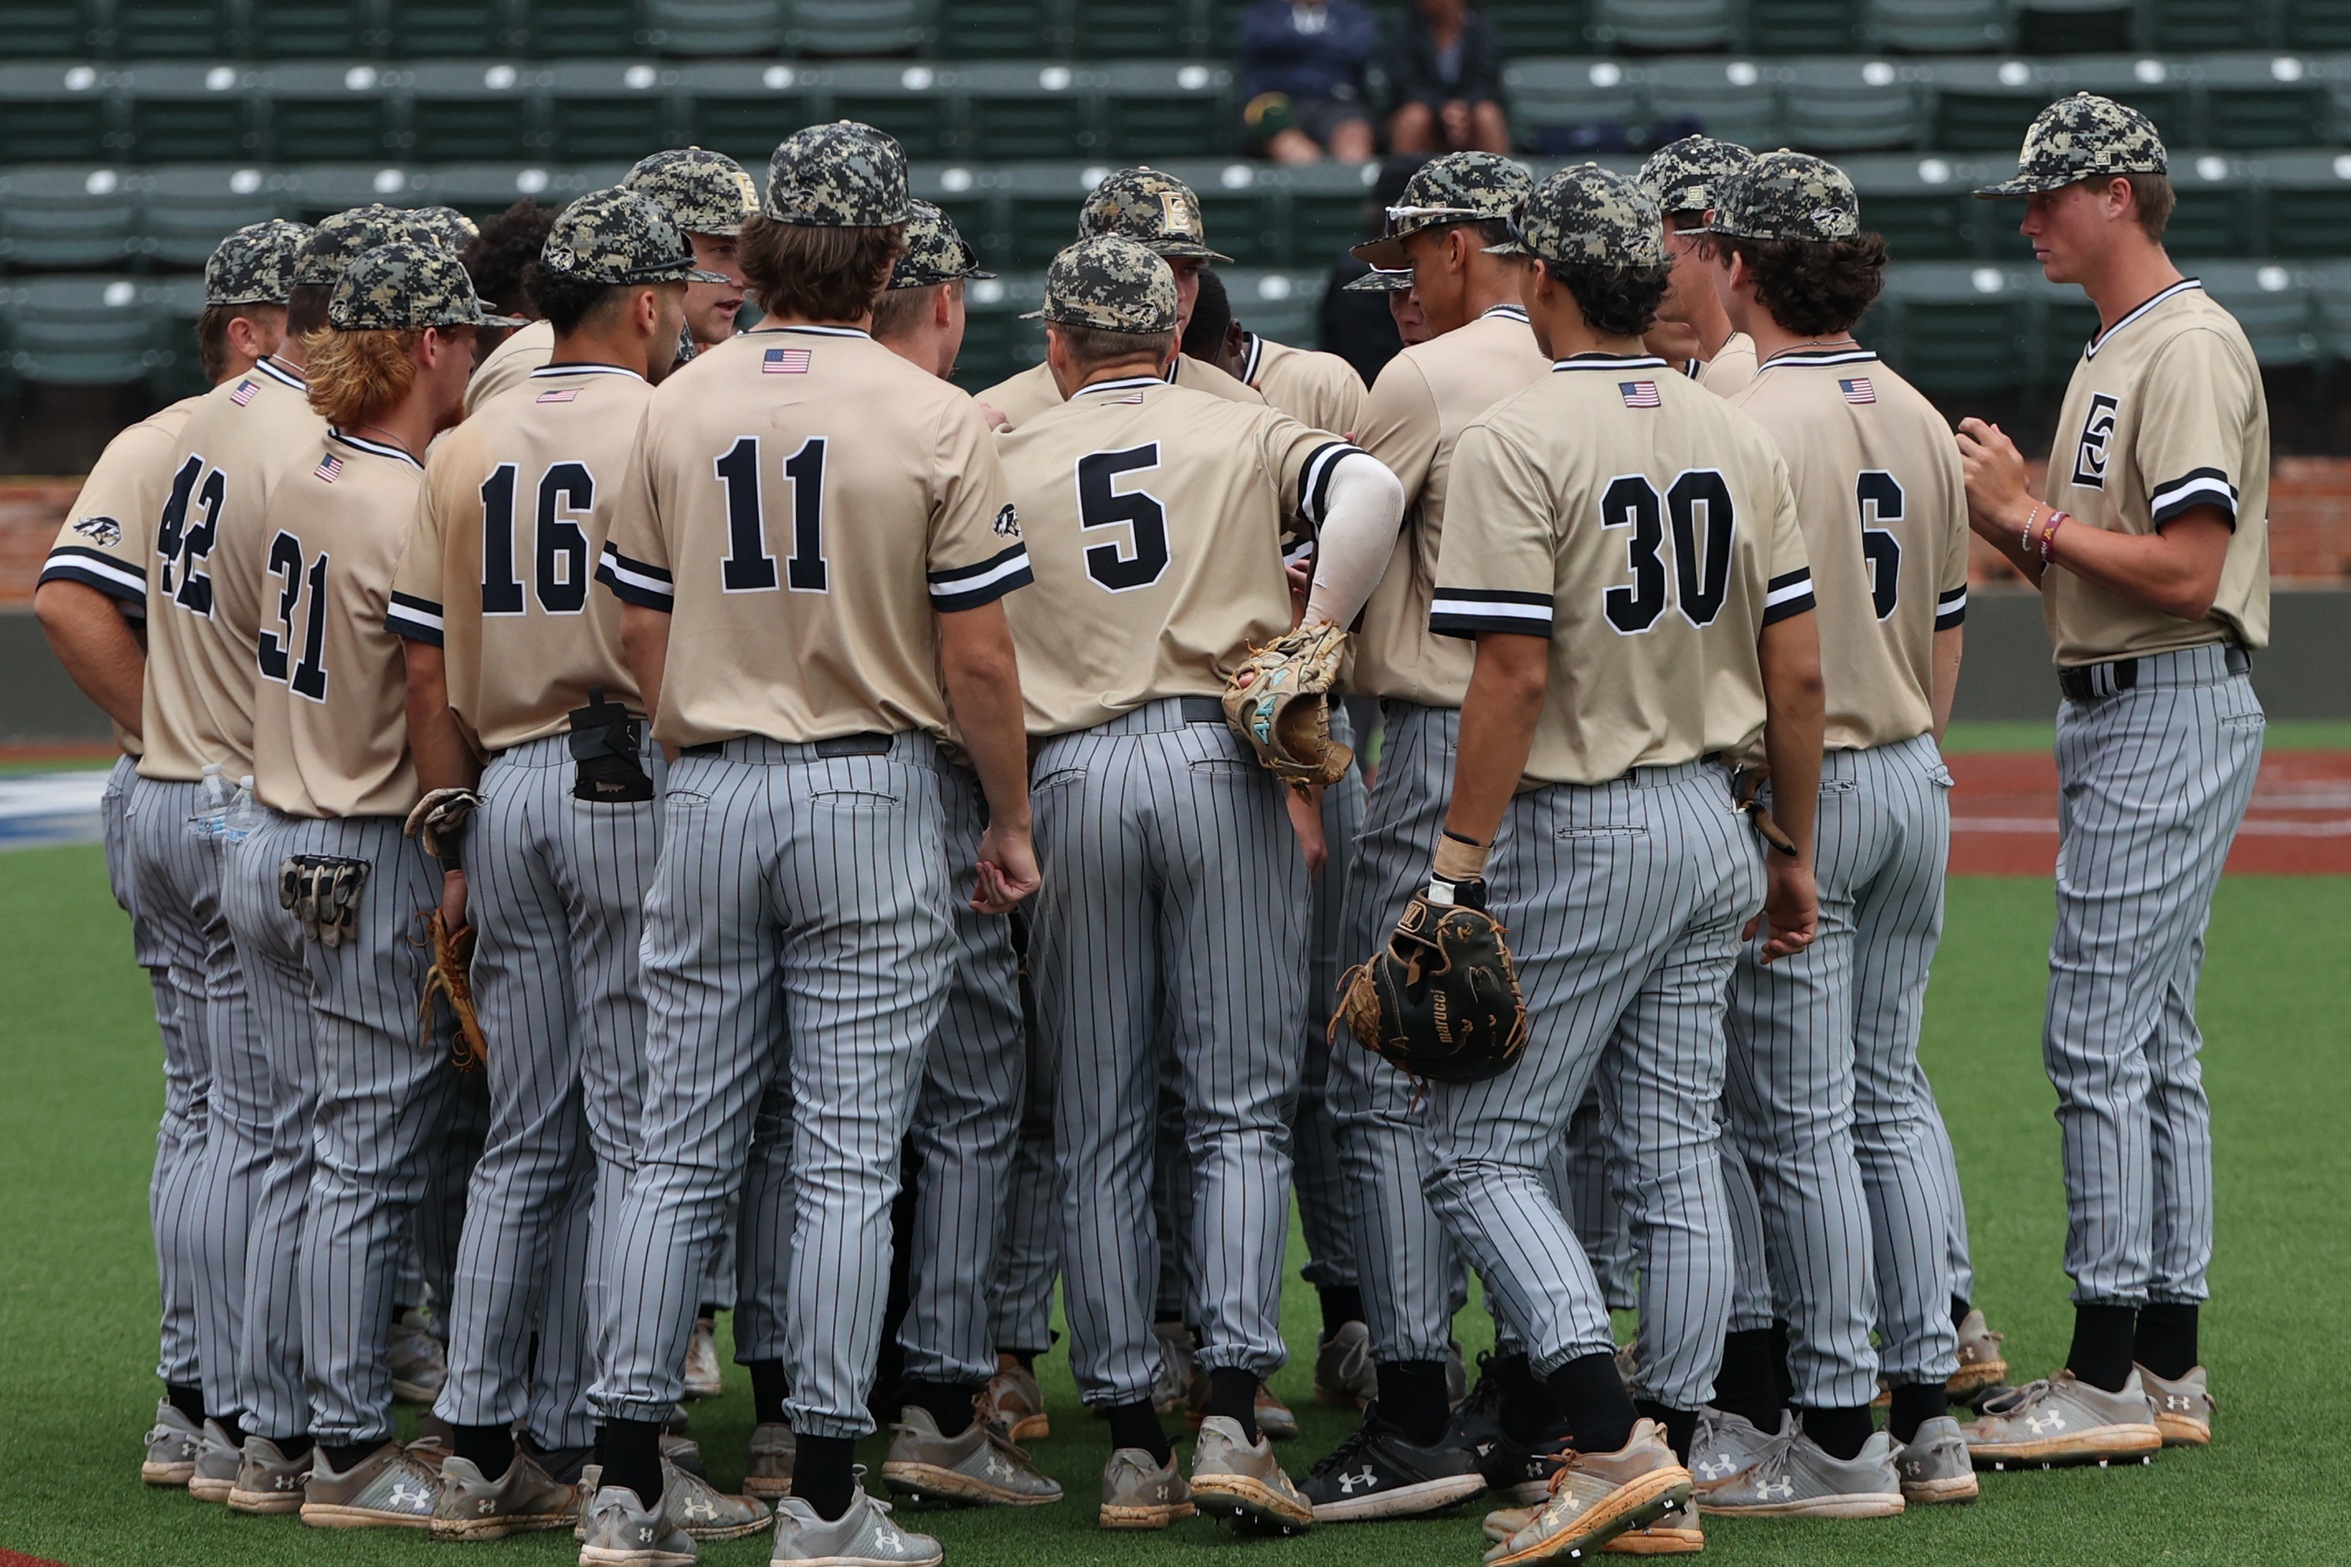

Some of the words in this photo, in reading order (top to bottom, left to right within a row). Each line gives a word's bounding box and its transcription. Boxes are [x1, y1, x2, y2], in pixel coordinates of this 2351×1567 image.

[157, 452, 227, 621] 42
[478, 460, 596, 616] 16
[713, 435, 829, 594] 11
[1075, 439, 1171, 594] 5
[1599, 468, 1735, 635] 30
[1855, 469, 1905, 622] 6
[257, 528, 330, 704] 31
[1430, 988, 1454, 1044] marucci
